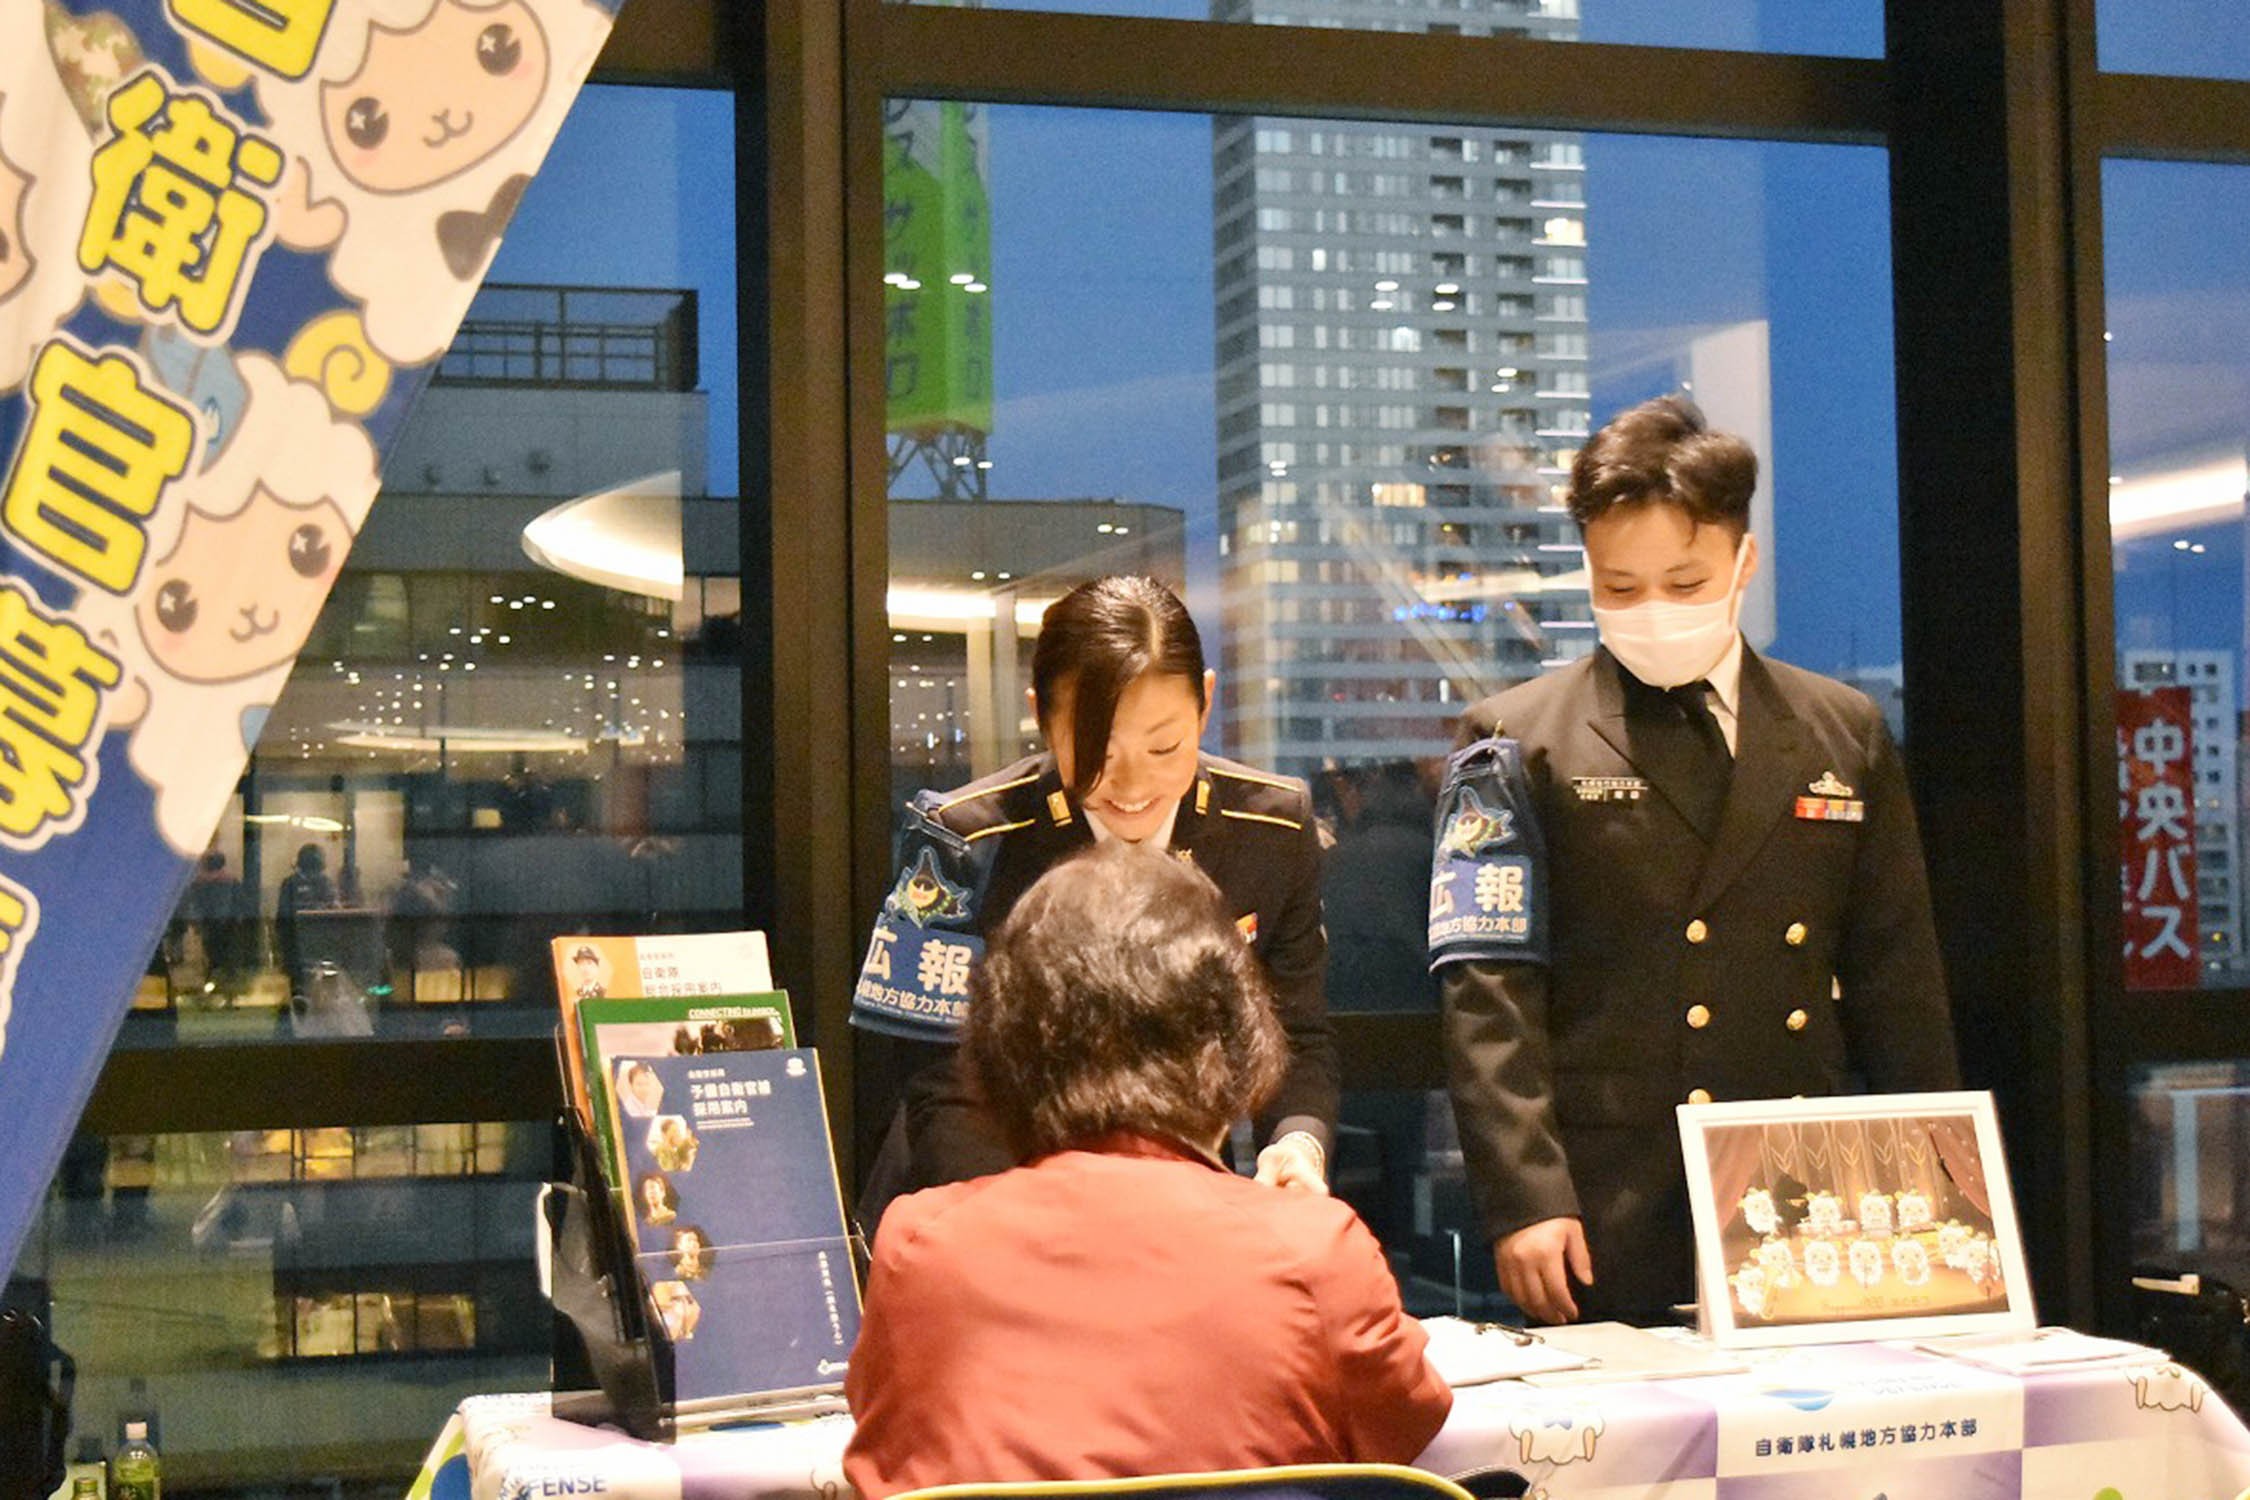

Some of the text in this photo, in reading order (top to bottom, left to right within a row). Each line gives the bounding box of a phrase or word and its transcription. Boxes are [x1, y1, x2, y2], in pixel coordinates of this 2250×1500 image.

[2134, 718, 2191, 959] 中央バス
[1430, 863, 1524, 919] 広報
[1755, 1418, 1978, 1457] 自衛隊札幌地方協力本部
